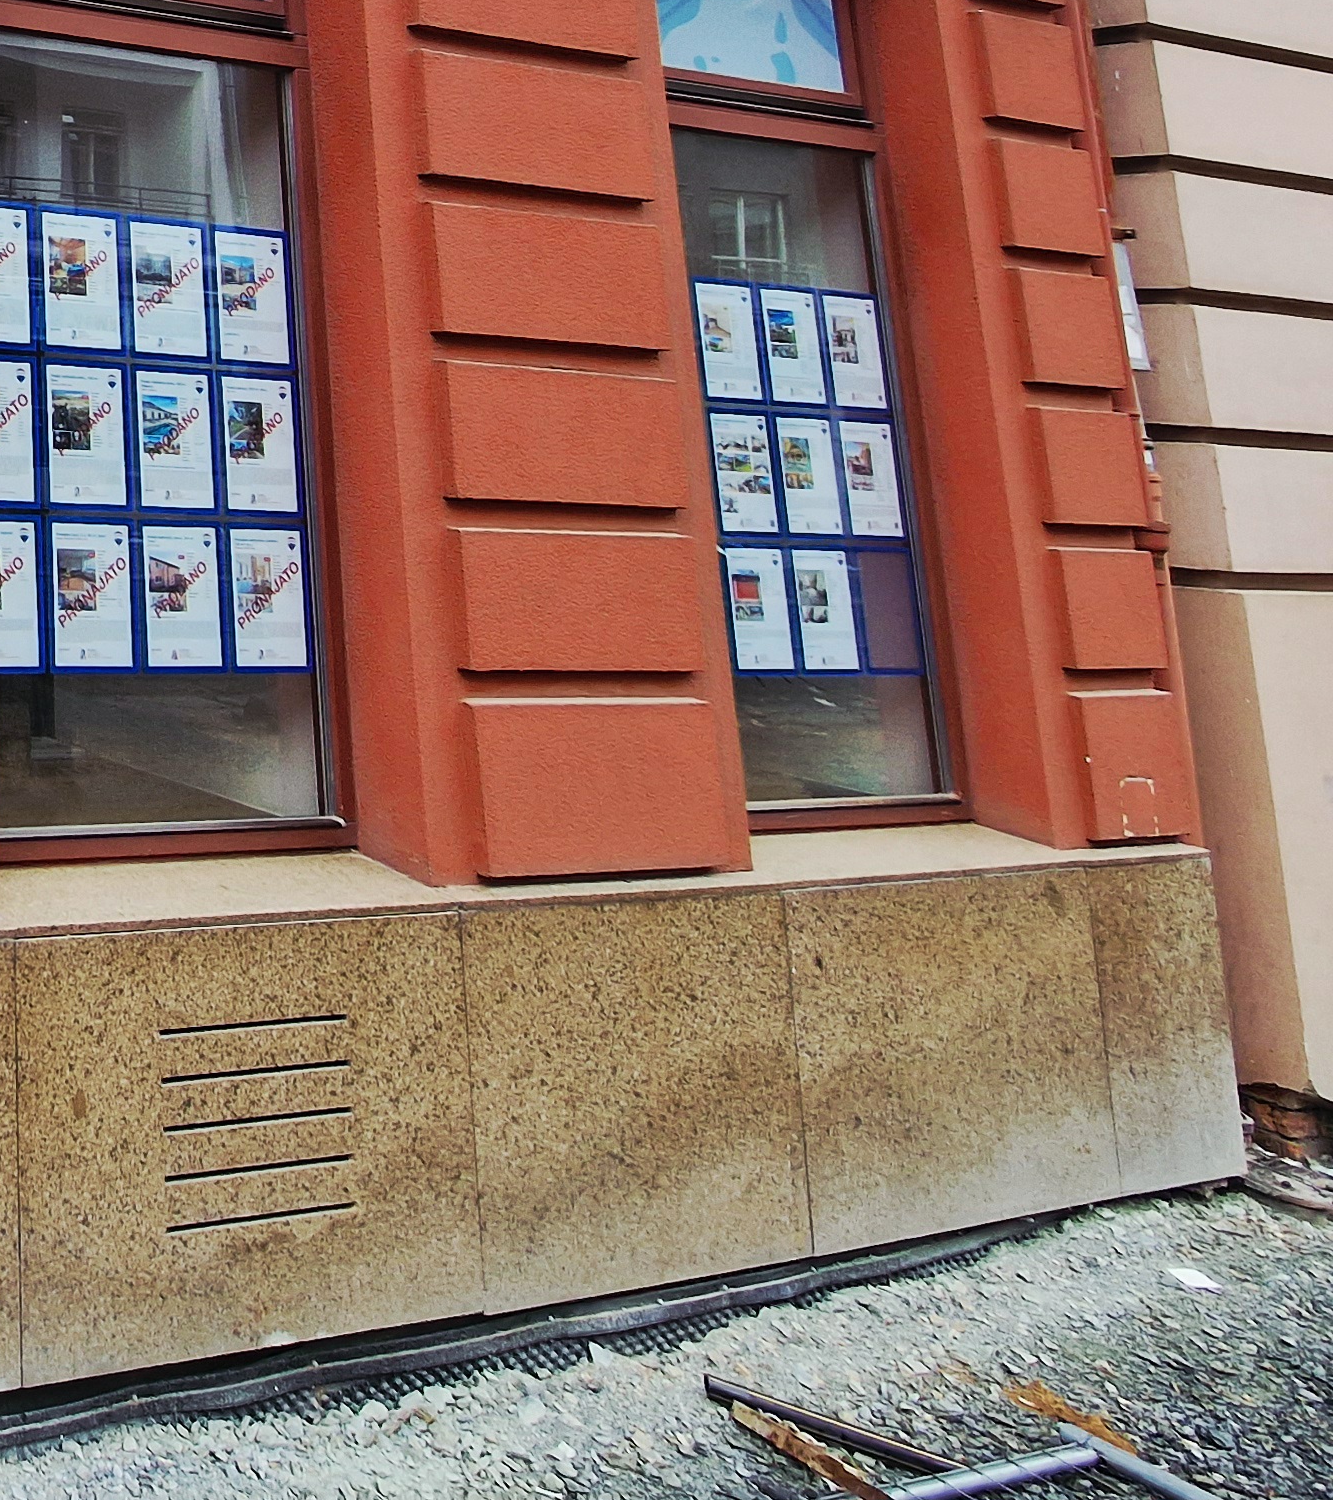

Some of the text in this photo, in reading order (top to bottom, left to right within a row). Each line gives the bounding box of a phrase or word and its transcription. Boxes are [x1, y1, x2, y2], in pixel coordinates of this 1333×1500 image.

[137, 257, 200, 318] PRONAJATO
[57, 557, 127, 628] PRONAJATO
[236, 561, 300, 629] PRONAJATO
